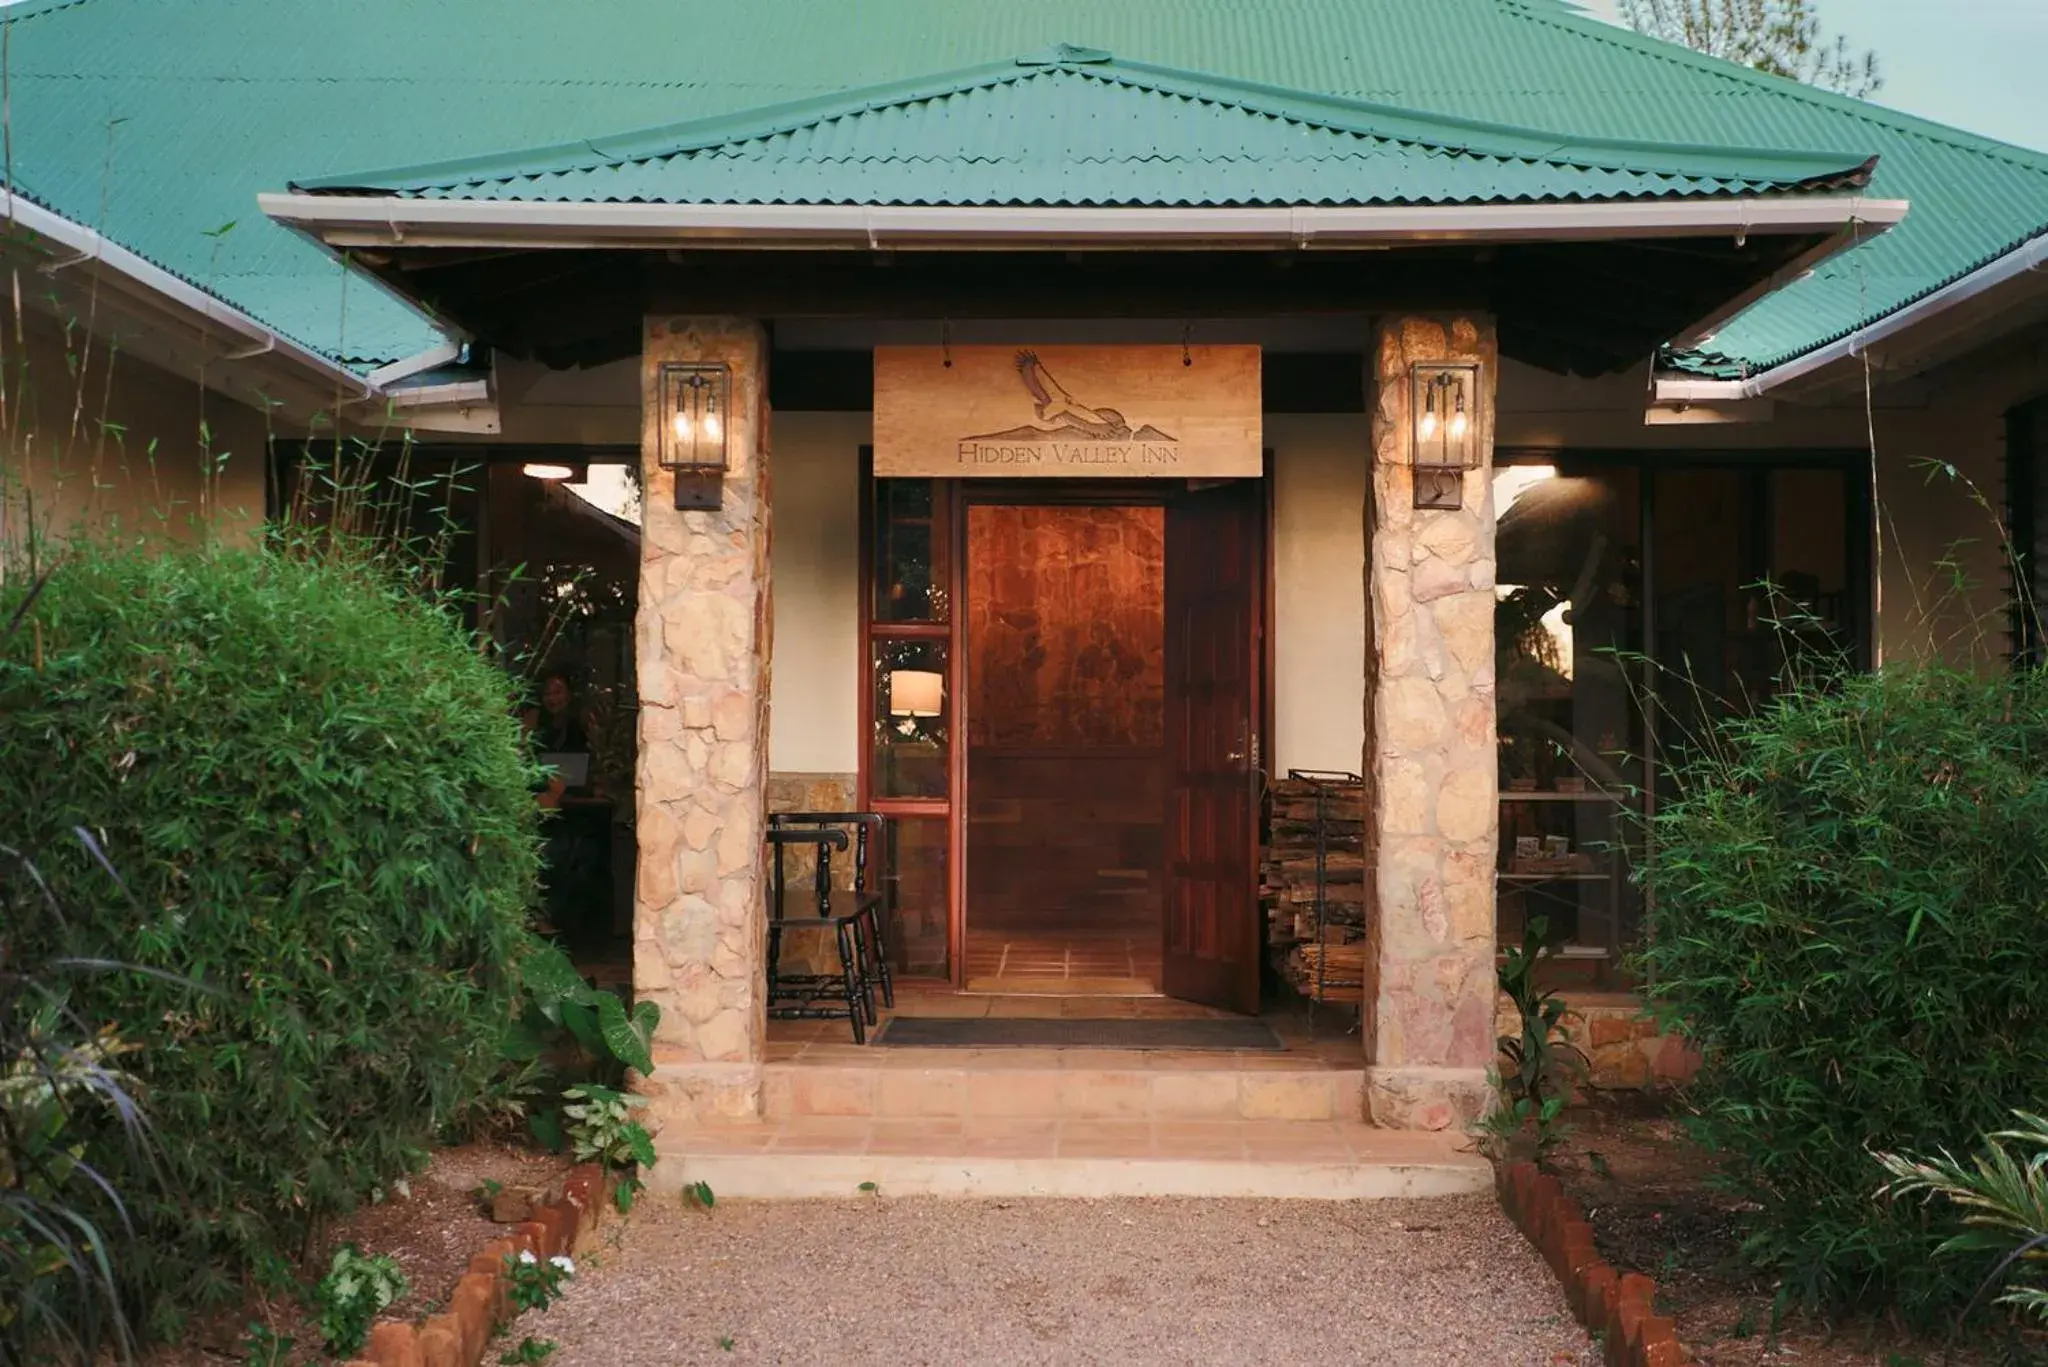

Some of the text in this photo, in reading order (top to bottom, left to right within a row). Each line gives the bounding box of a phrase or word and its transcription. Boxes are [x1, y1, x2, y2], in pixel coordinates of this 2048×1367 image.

[957, 443, 1178, 463] HIDDEN VALLEY INN
